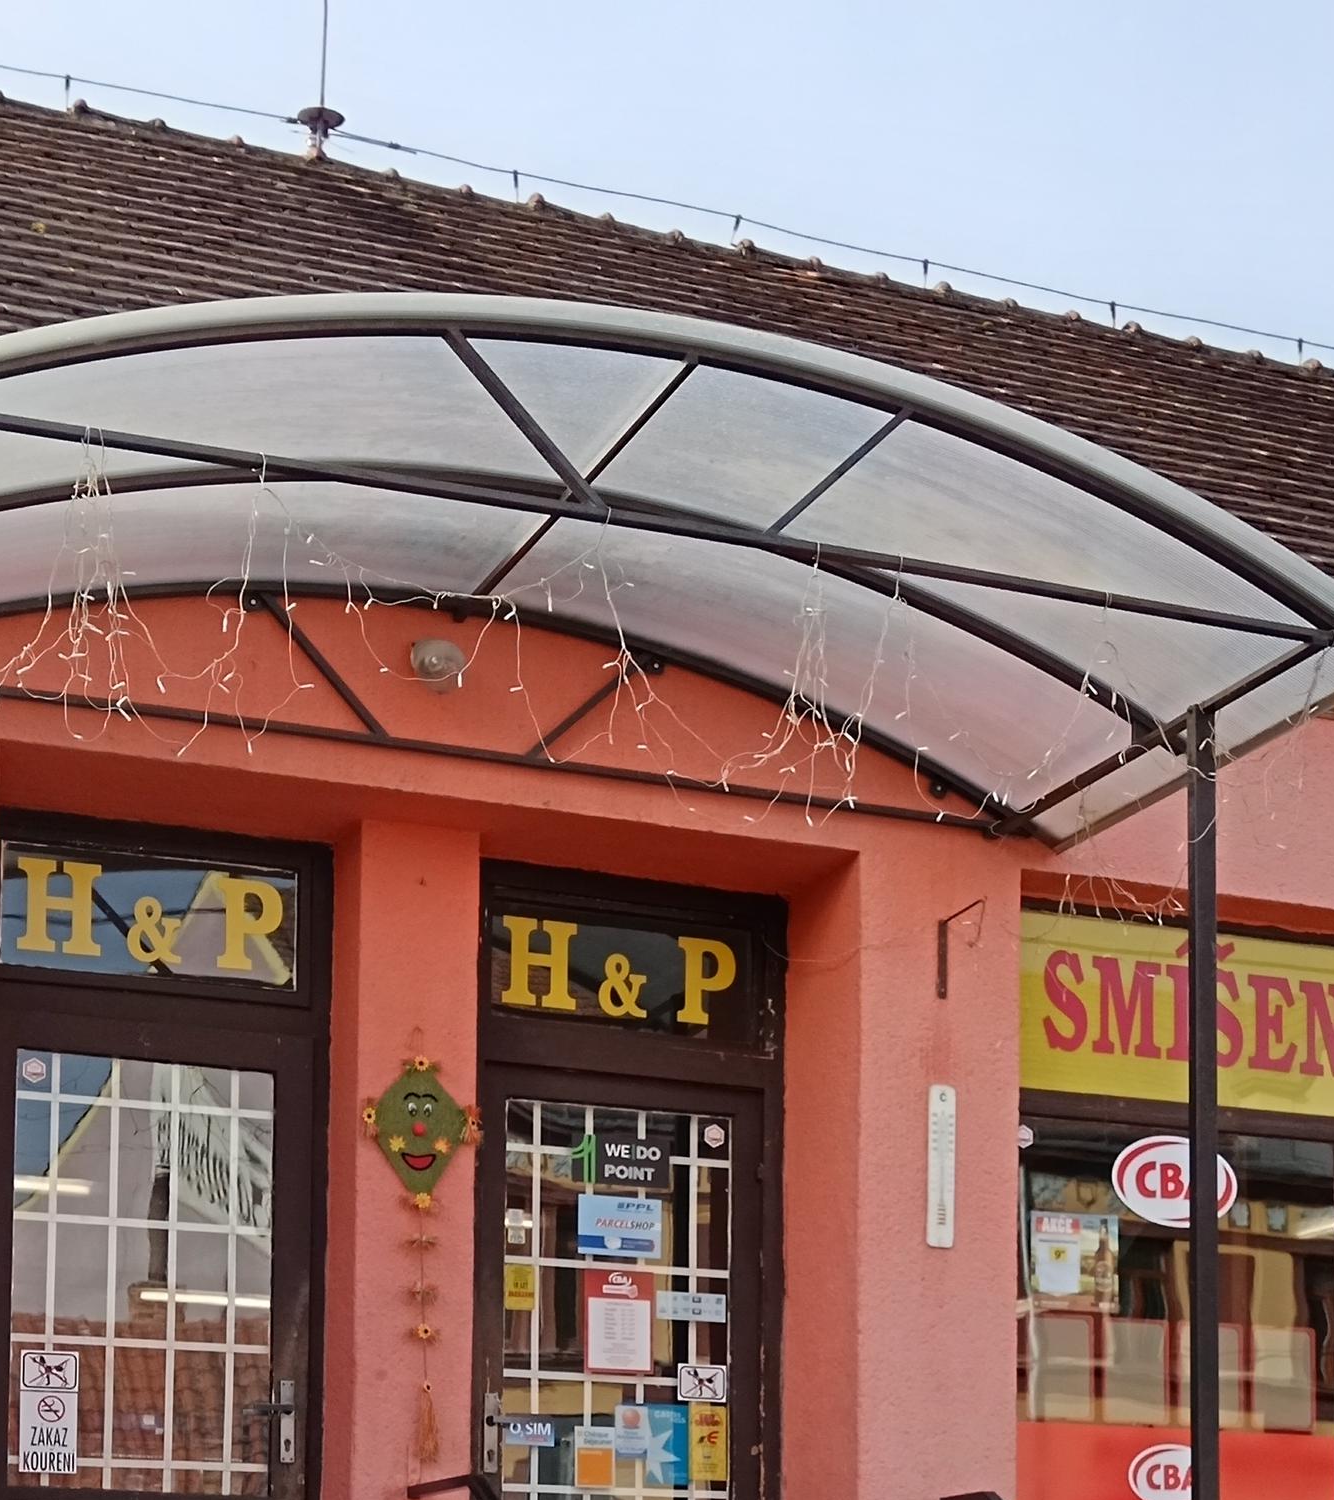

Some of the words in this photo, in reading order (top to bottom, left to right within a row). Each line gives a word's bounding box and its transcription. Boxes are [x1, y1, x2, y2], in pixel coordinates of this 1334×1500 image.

[16, 856, 103, 958] H
[126, 894, 182, 965] &
[215, 876, 284, 972] P
[500, 914, 578, 1012] H
[597, 952, 648, 1019] &
[675, 936, 737, 1026] P
[604, 1163, 655, 1182] POINT
[1135, 1160, 1190, 1200] CB
[30, 1424, 69, 1448] ZÁKAZ
[525, 1422, 552, 1436] SIM
[23, 1447, 75, 1473] KOUŘENÍ
